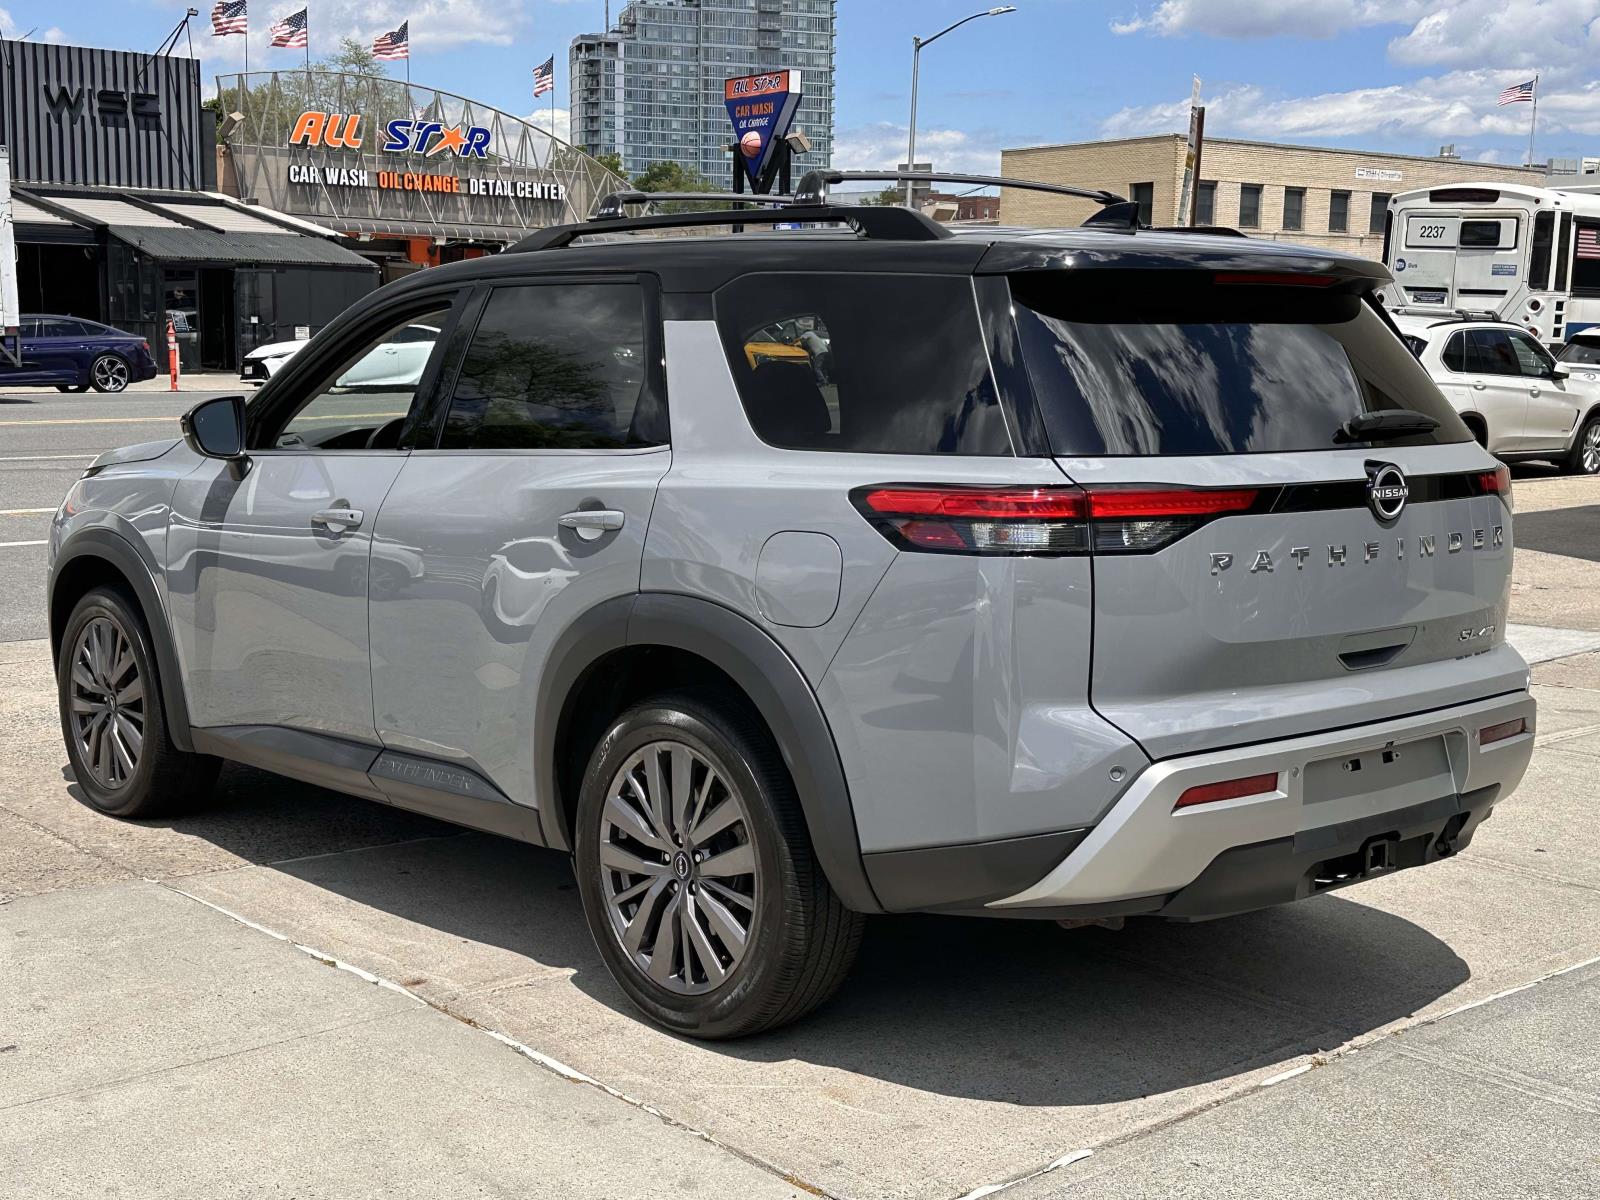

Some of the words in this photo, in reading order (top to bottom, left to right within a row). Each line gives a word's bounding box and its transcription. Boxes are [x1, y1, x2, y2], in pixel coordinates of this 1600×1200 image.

[732, 80, 749, 95] ALL
[43, 84, 163, 118] WISE
[736, 105, 750, 117] CAR
[752, 102, 774, 115] WASH
[289, 111, 364, 148] ALL
[383, 119, 491, 159] STAR
[289, 165, 319, 184] CAR
[325, 167, 368, 187] WASH
[379, 171, 402, 189] OIL
[403, 173, 460, 193] CHANGE
[469, 178, 514, 197] DETAIL
[516, 181, 566, 201] CENTER
[1420, 225, 1446, 239] 2237
[1372, 487, 1409, 498] NISSAN
[1209, 525, 1504, 576] PATHFINDER
